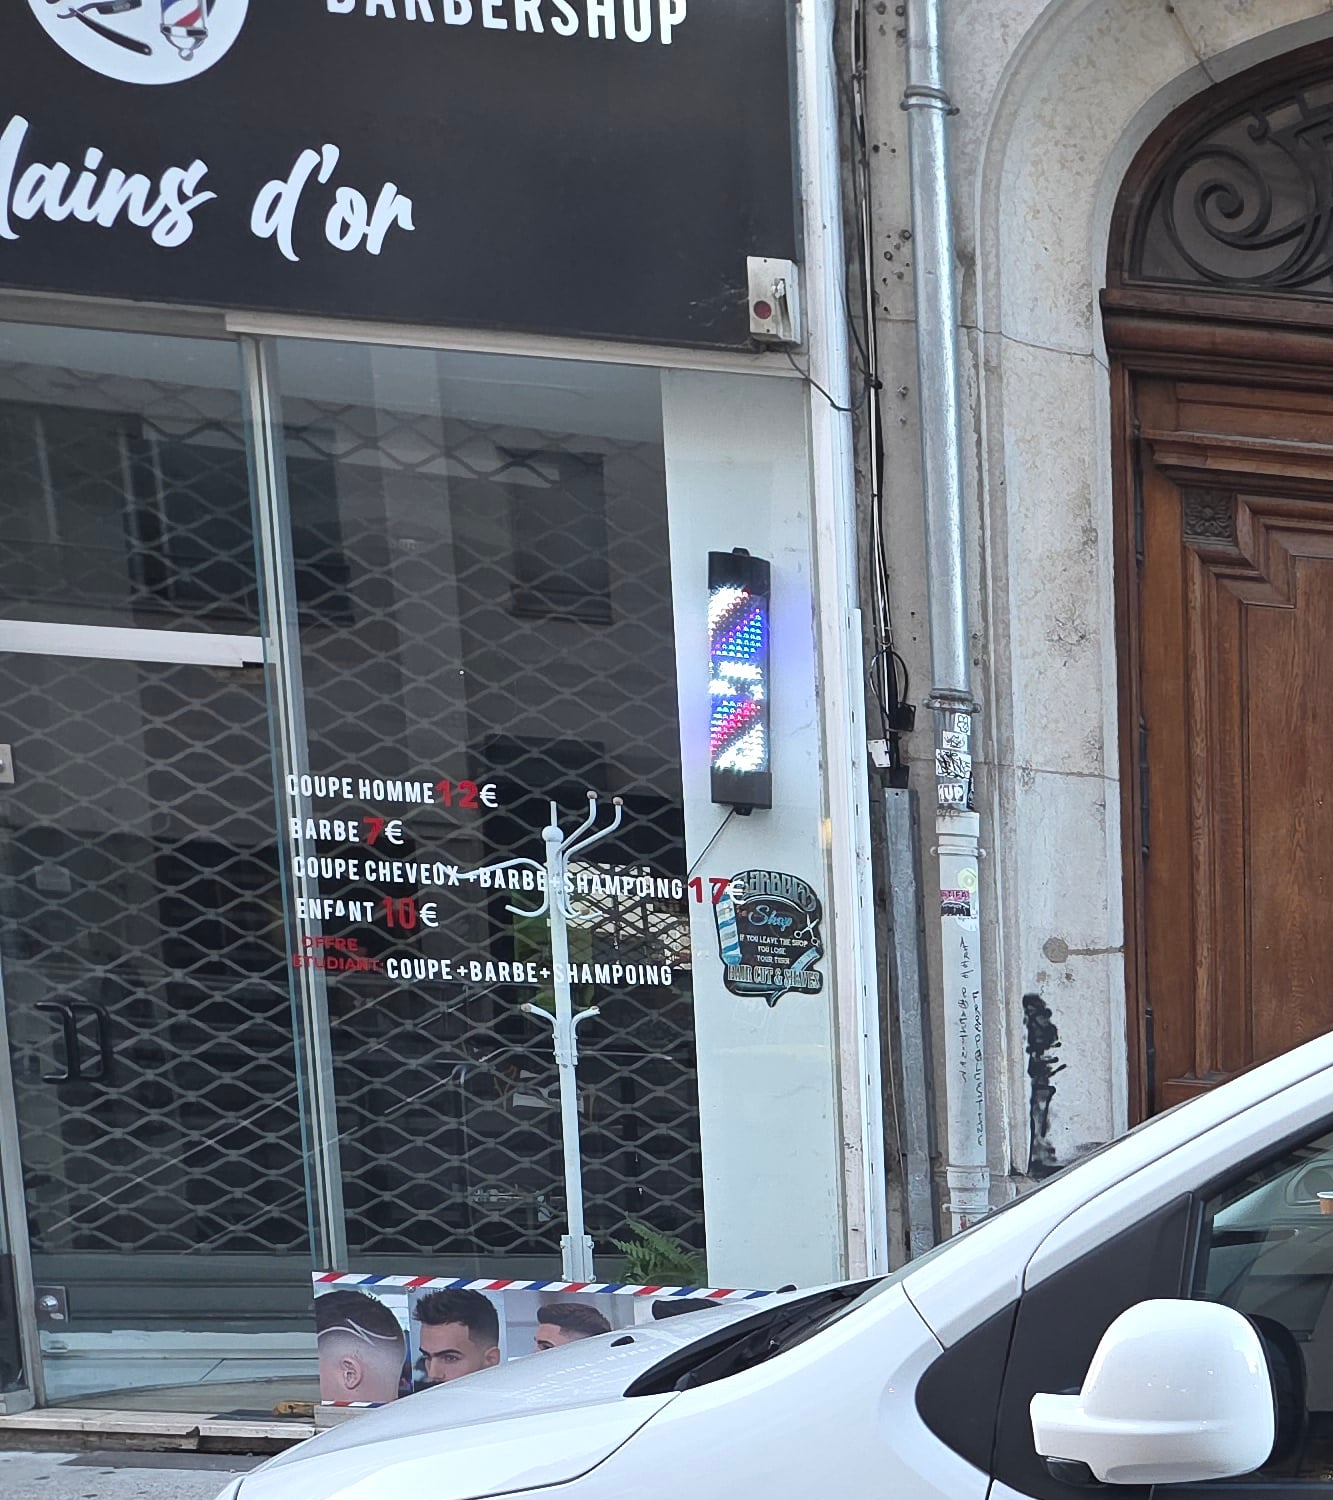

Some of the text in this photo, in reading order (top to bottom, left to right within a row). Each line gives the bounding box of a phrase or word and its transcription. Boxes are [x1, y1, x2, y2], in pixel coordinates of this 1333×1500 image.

[326, 0, 687, 44] BERSHOP
[251, 143, 415, 262] d'or
[287, 775, 353, 799] COUPE
[358, 779, 435, 804] HOMME
[290, 817, 360, 842] BARBE
[293, 857, 360, 880] COUPE
[296, 897, 375, 922] ENFANT
[302, 935, 359, 951] OFFRE
[386, 958, 452, 980] COUPE
[727, 964, 753, 983] HAIR
[753, 966, 774, 985] CUT
[783, 968, 820, 989] SHAVES
